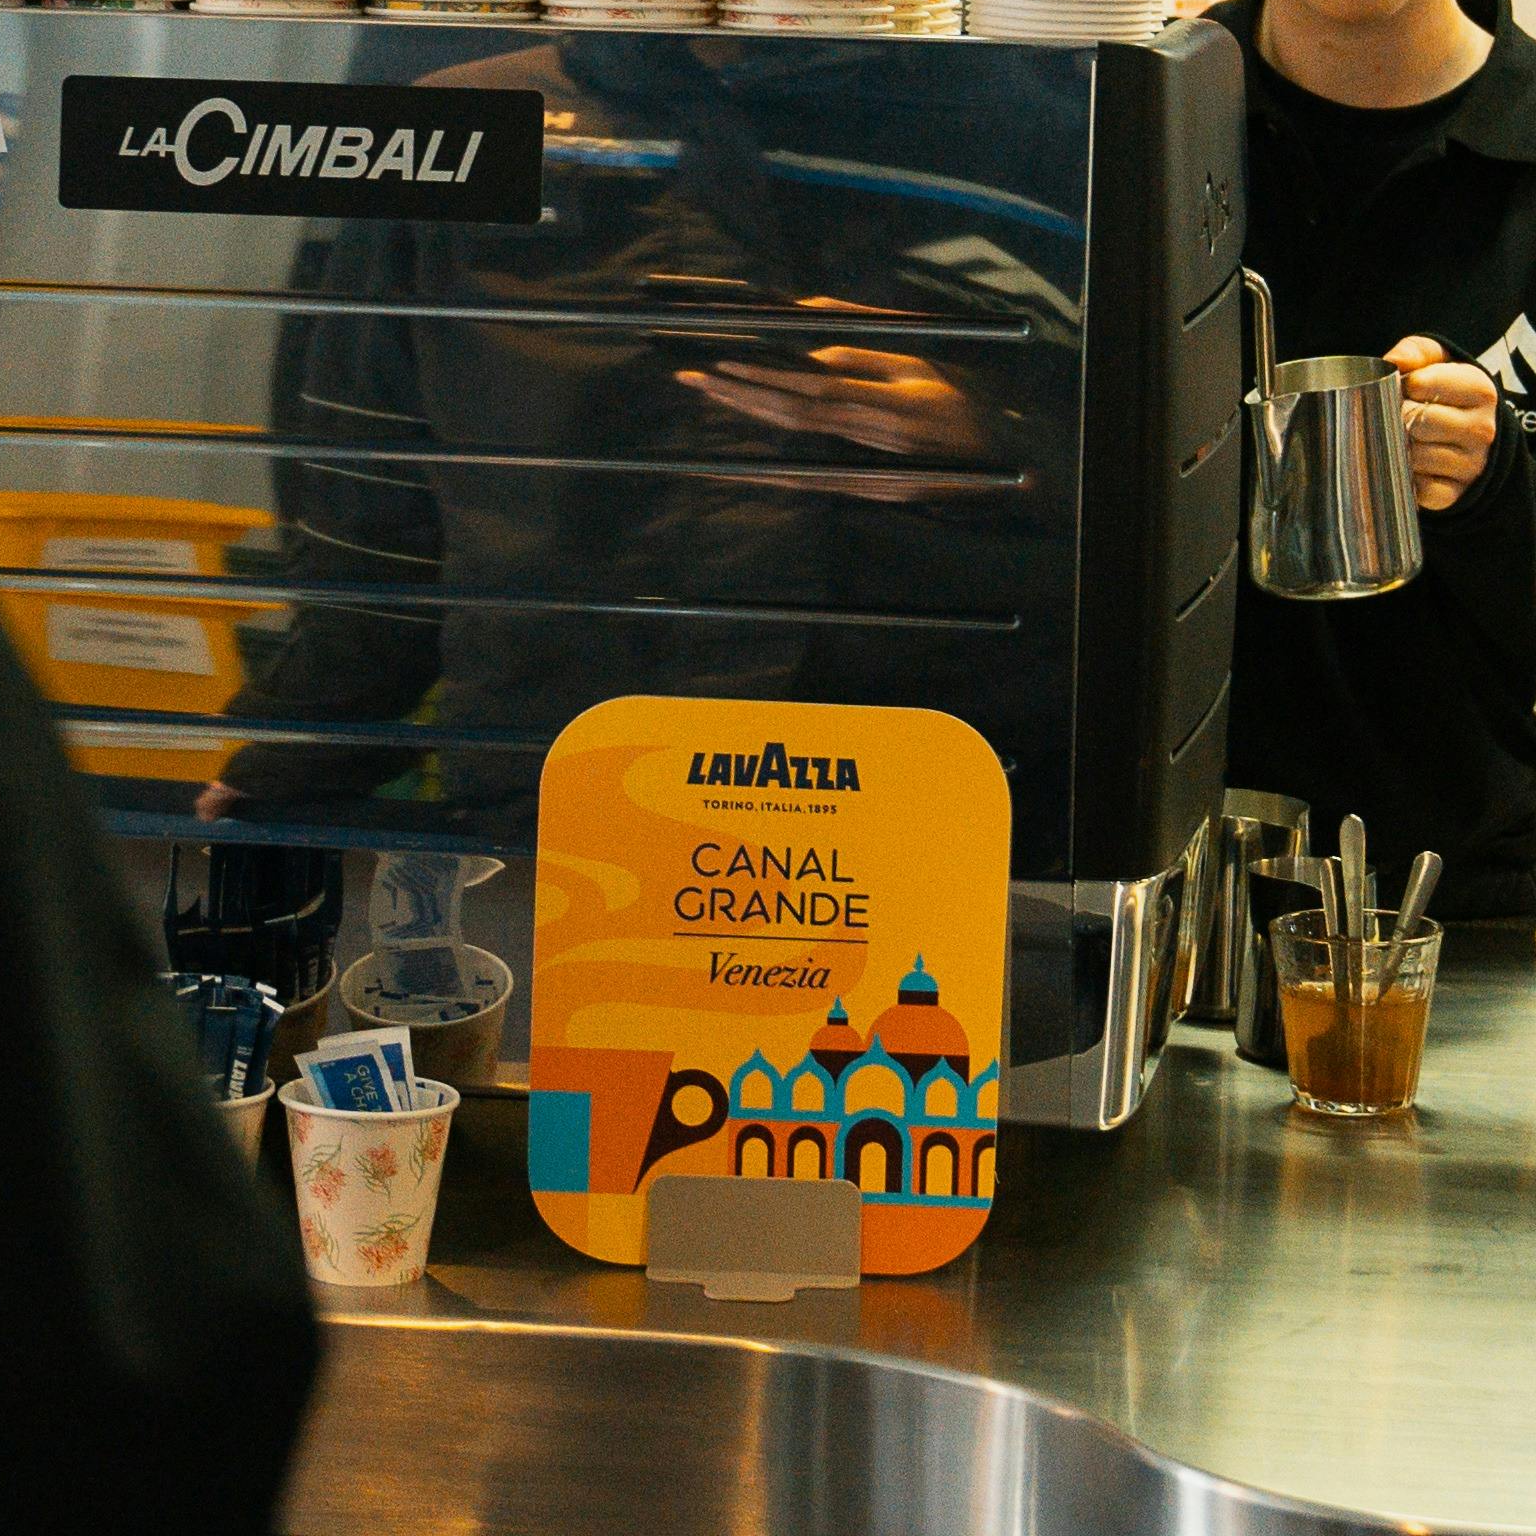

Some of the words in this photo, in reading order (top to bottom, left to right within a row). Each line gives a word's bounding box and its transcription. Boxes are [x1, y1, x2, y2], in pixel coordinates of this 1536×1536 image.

[687, 742, 861, 792] LAVAZZA
[691, 843, 854, 883] CANAL
[674, 887, 870, 929] GRANDE
[708, 951, 831, 990] Venezia
[357, 1065, 378, 1101] GIVE
